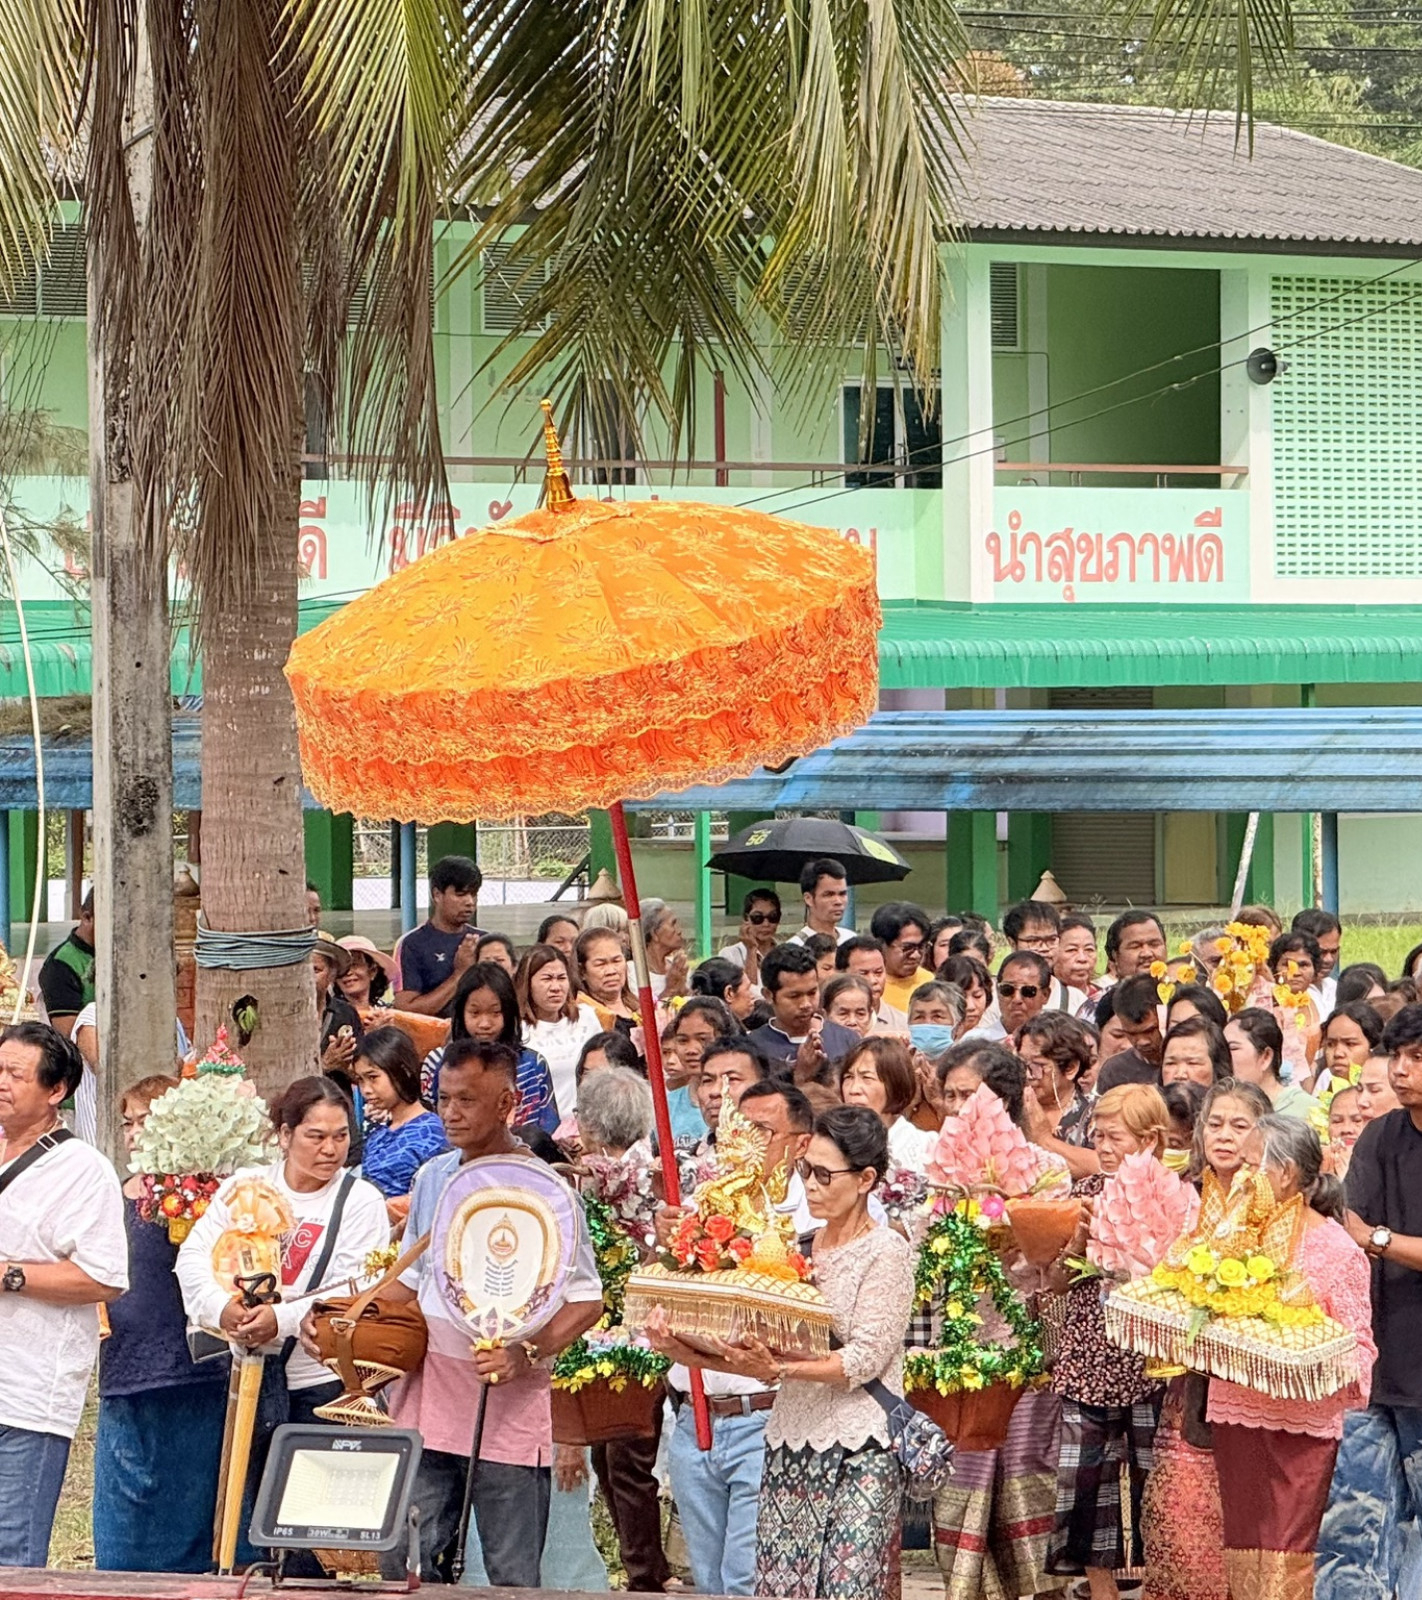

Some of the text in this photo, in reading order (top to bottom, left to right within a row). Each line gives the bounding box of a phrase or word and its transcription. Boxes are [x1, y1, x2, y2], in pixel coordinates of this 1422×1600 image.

[985, 507, 1224, 603] นำสุขภาพดี
[273, 1526, 293, 1536] IP65
